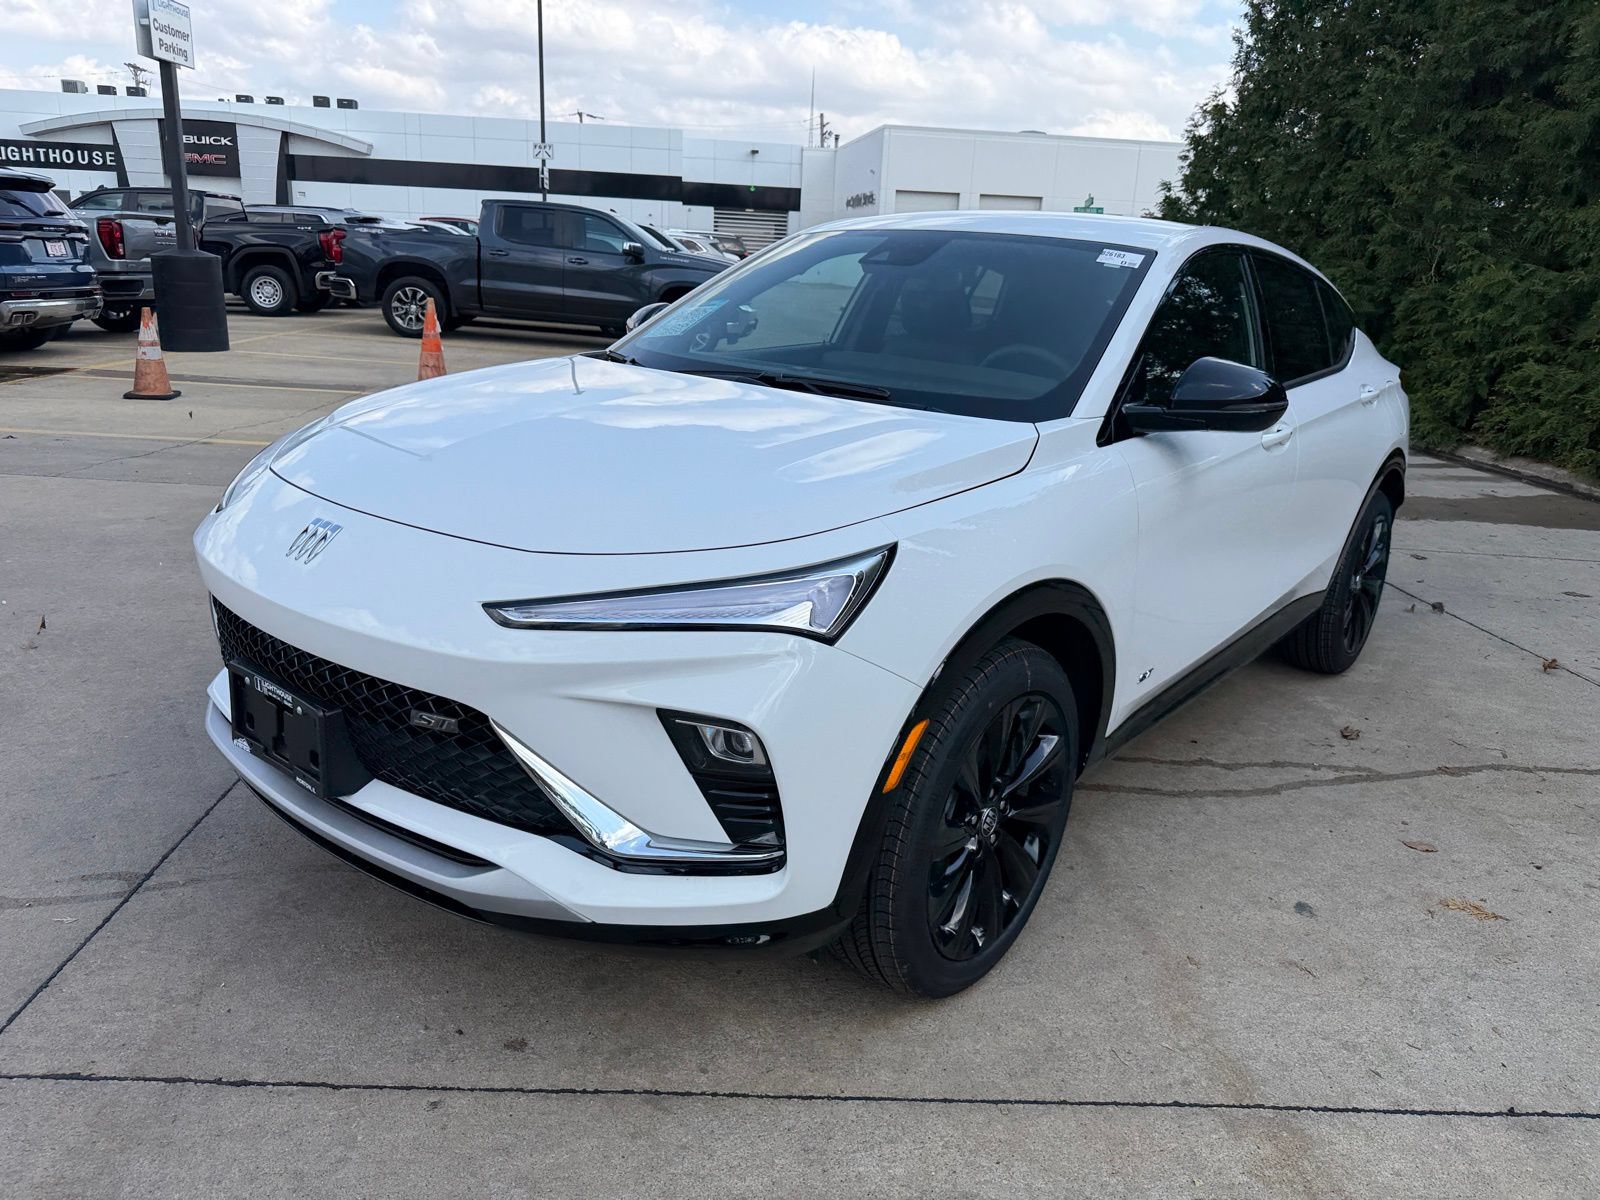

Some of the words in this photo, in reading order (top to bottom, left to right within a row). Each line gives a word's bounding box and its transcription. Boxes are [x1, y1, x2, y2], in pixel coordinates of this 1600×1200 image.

[153, 18, 190, 42] Customer
[159, 38, 188, 62] Parking
[183, 134, 234, 146] BUICK
[0, 146, 117, 166] IGHTHOUSE
[262, 680, 293, 702] LIGHTHOUSE
